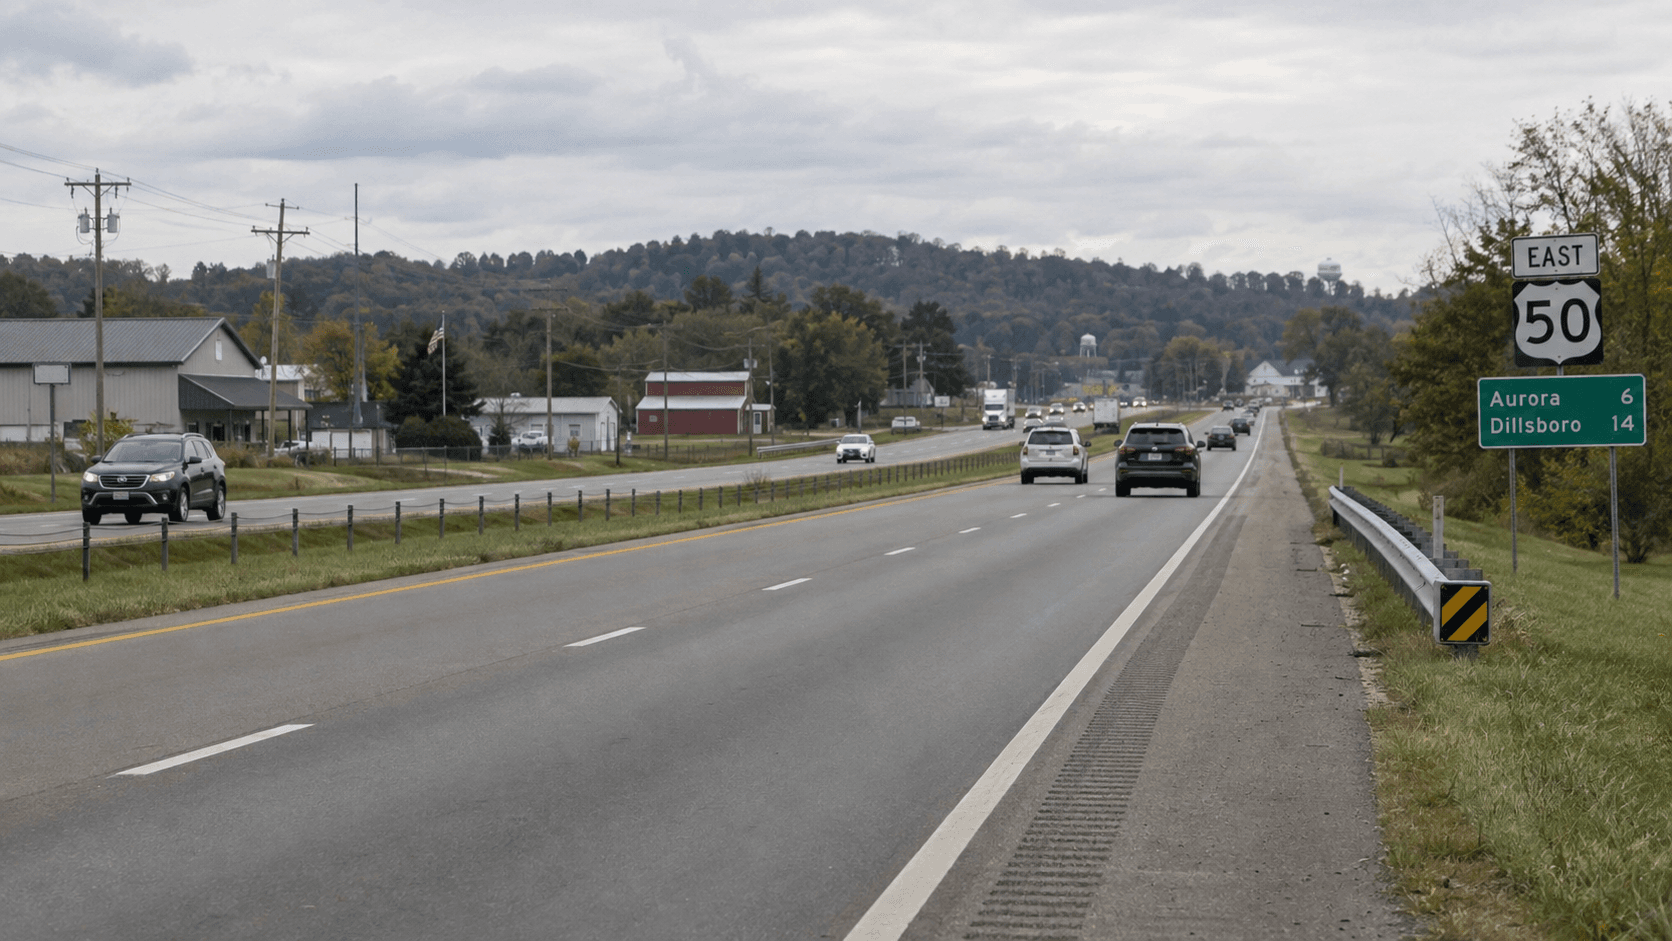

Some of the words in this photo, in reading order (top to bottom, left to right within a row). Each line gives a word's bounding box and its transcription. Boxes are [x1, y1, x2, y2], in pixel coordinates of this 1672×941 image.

[1527, 244, 1583, 268] EAST
[1526, 298, 1590, 344] 50
[1490, 390, 1560, 407] Aurora
[1621, 388, 1633, 405] 6
[1490, 417, 1581, 434] Dillsboro
[1612, 415, 1634, 432] 14
